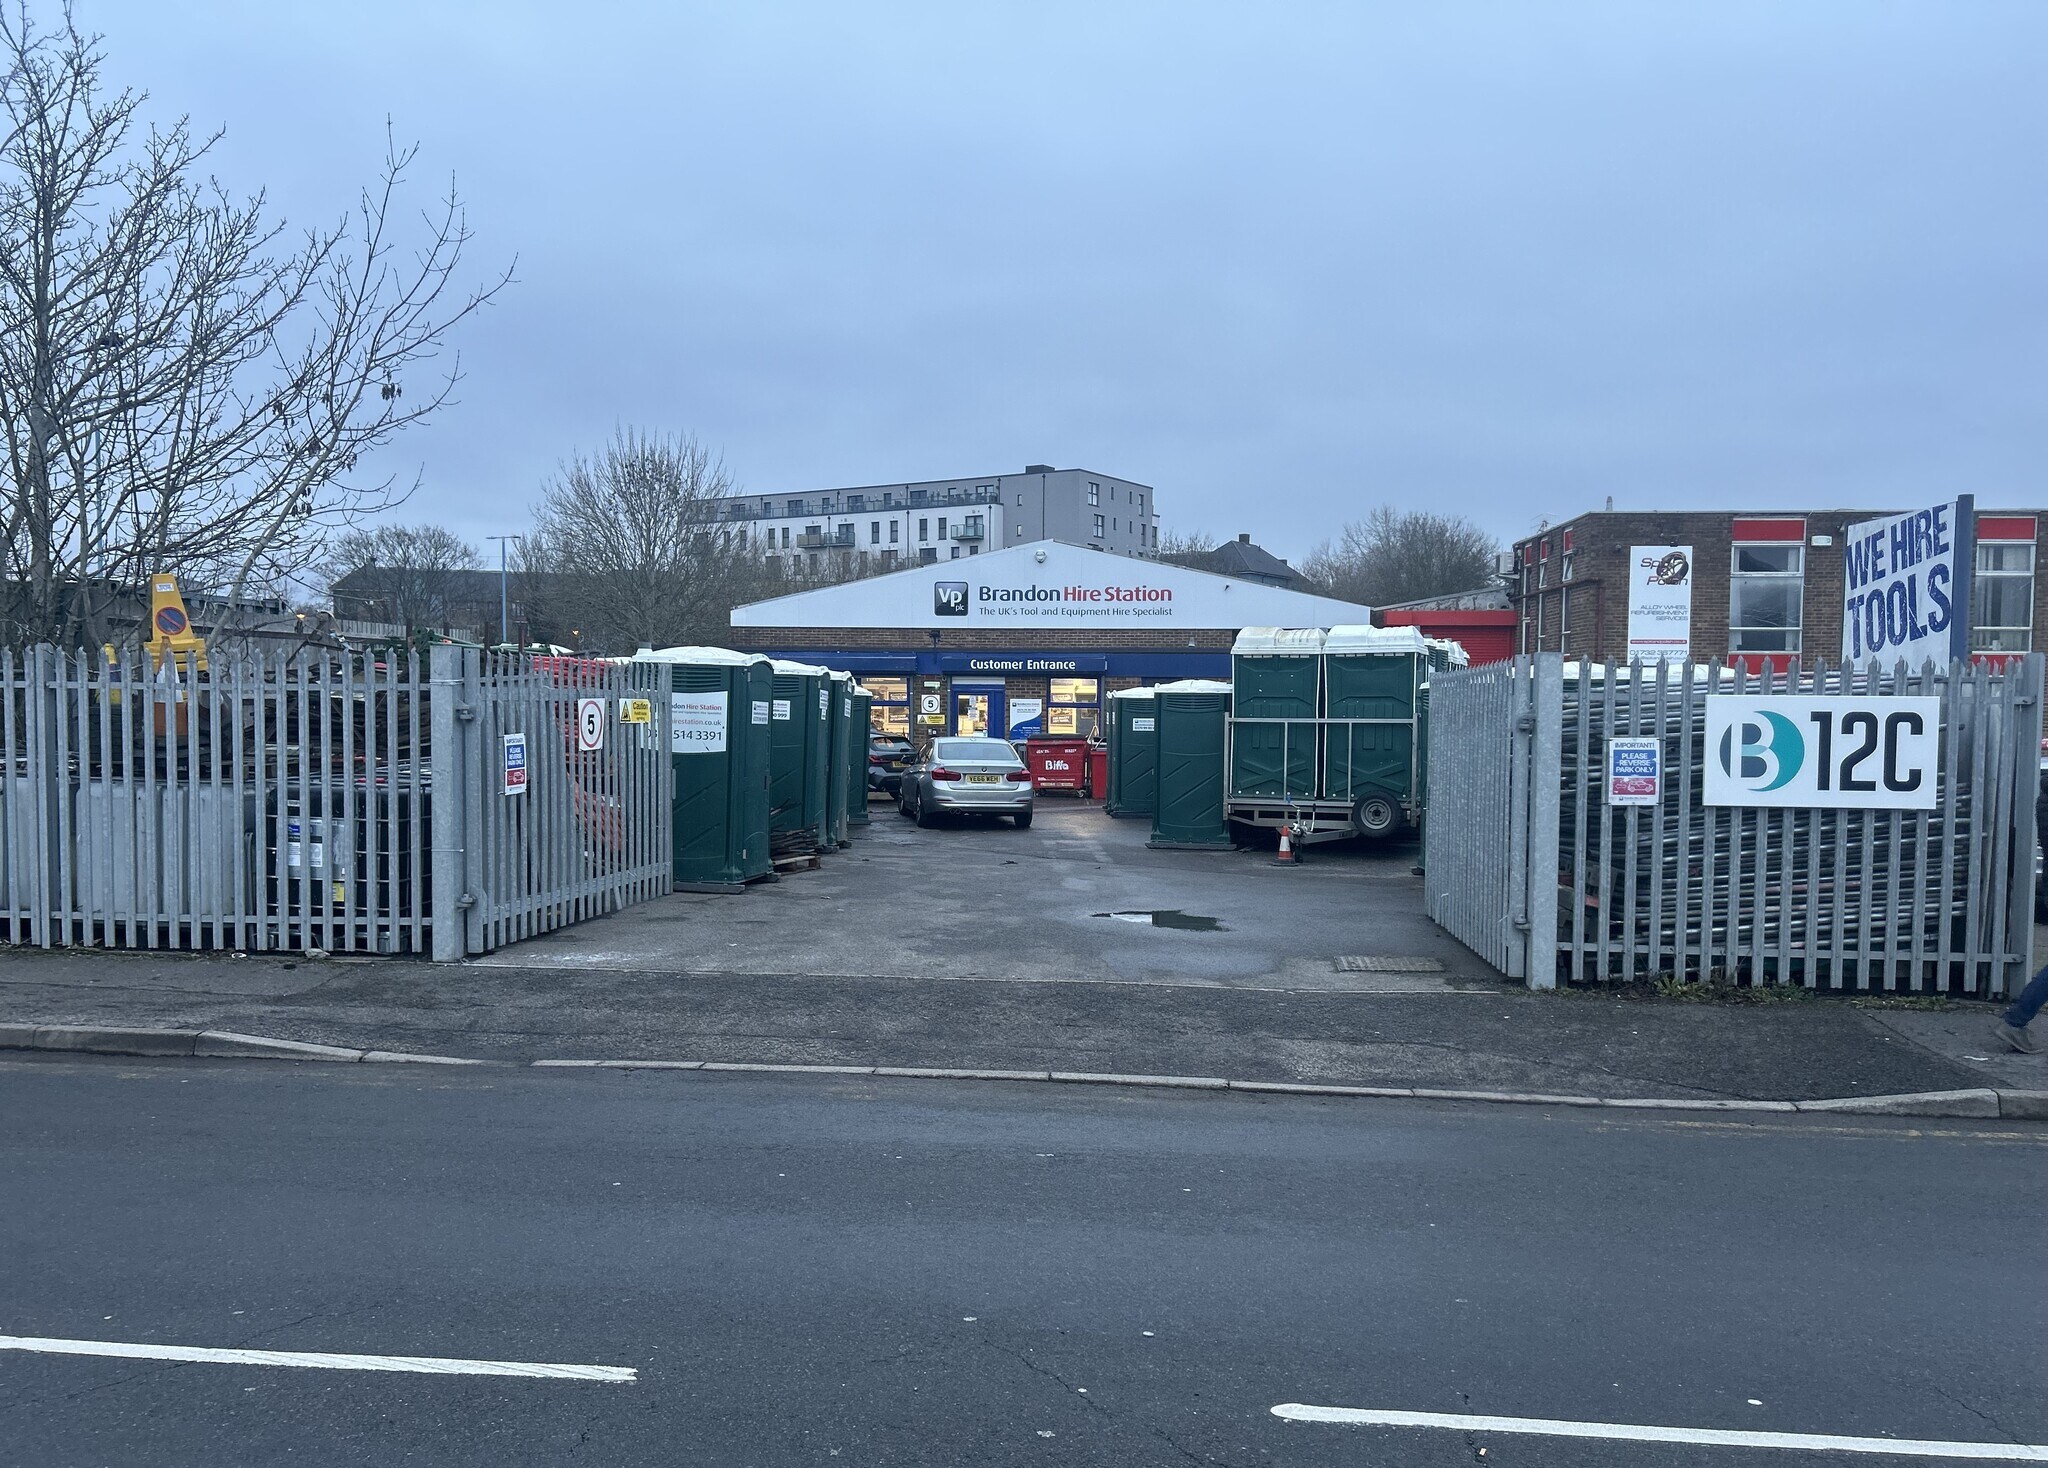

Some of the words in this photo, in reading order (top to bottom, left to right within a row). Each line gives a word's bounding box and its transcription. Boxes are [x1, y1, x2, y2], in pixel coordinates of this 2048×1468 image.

[1846, 529, 1886, 590] WE
[1891, 504, 1949, 574] HIRE
[938, 588, 962, 607] Vp
[979, 584, 1060, 602] Brandon
[1064, 585, 1101, 602] Hire
[1104, 585, 1172, 602] Station
[980, 607, 995, 615] The
[998, 607, 1017, 616] UK's
[1020, 607, 1038, 615] Tool
[1041, 607, 1058, 616] and
[1061, 608, 1110, 617] Equipment
[1112, 607, 1130, 616] Hire
[1132, 607, 1172, 617] Specialist
[1847, 563, 1951, 659] TOOLS
[970, 659, 1023, 670] Customer
[1027, 659, 1076, 670] Entrance
[686, 703, 699, 711] Hire
[928, 700, 934, 709] 5
[587, 714, 595, 735] 5
[673, 729, 693, 740] 514
[695, 730, 722, 741] 3391
[1621, 752, 1648, 760] PLEASE
[1810, 711, 1924, 792] 12C
[1045, 759, 1069, 771] Biffa
[1619, 759, 1650, 767] REVERSE
